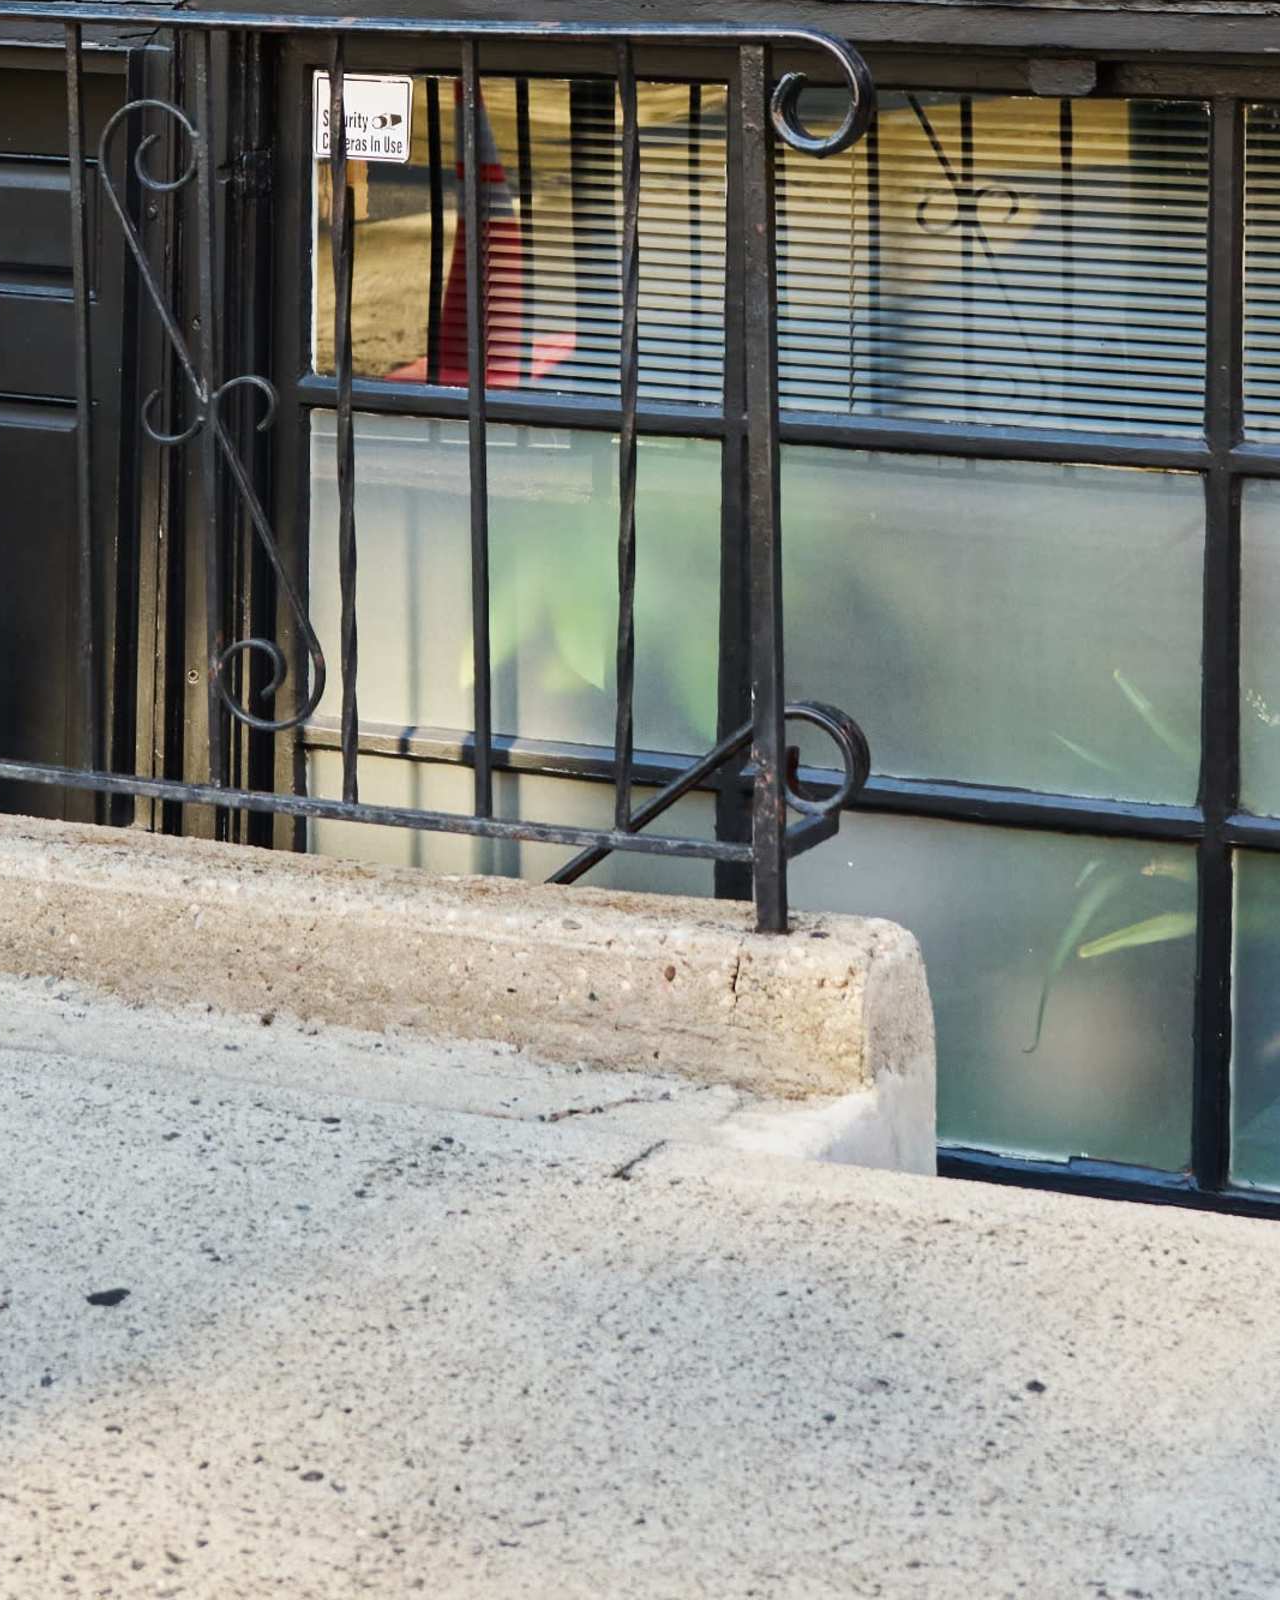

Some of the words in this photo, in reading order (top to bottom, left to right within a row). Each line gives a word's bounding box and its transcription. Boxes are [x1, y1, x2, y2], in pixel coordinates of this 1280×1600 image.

[323, 109, 369, 133] Surity
[322, 132, 368, 152] Ceras
[370, 135, 381, 152] In
[384, 136, 403, 154] Use
